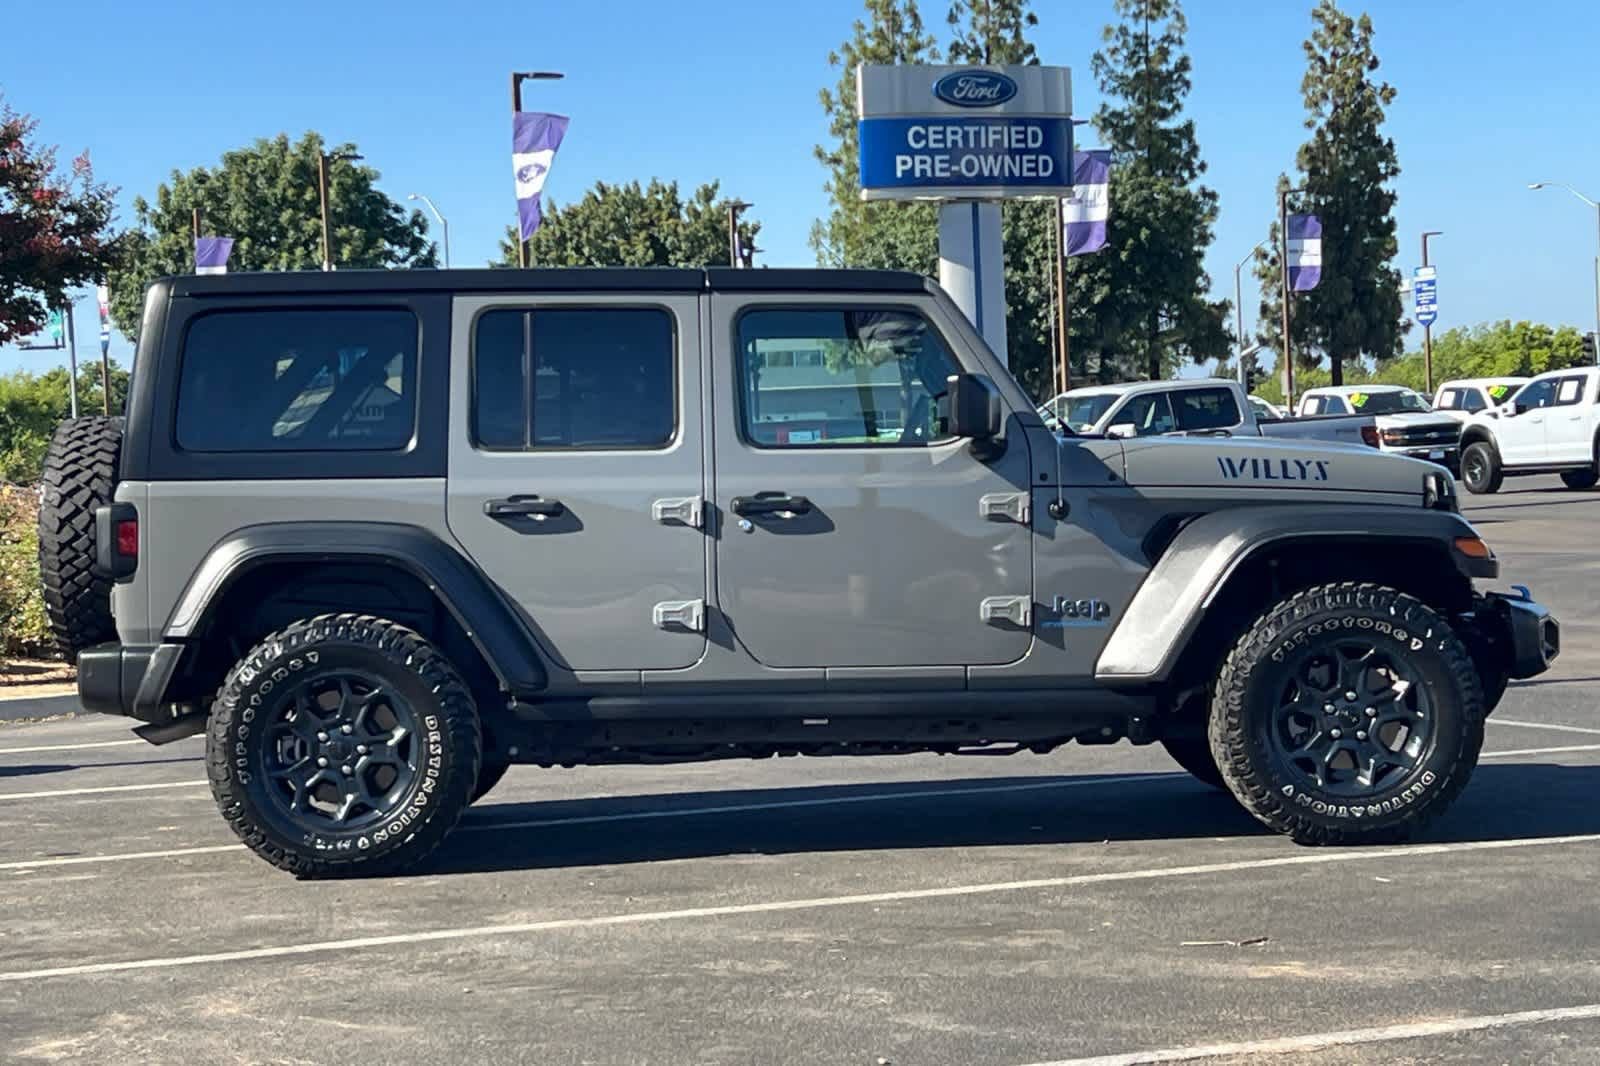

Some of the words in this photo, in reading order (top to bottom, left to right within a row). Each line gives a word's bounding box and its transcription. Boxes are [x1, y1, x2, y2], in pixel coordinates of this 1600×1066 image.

[953, 76, 1001, 99] Ford
[907, 125, 1044, 149] CERTIFIED
[895, 154, 1054, 178] PRE-OWNED
[1217, 457, 1330, 481] WILLYS
[1052, 595, 1110, 621] Jeep
[373, 715, 442, 844] DESTINATION
[1295, 770, 1437, 818] DESTINATION
